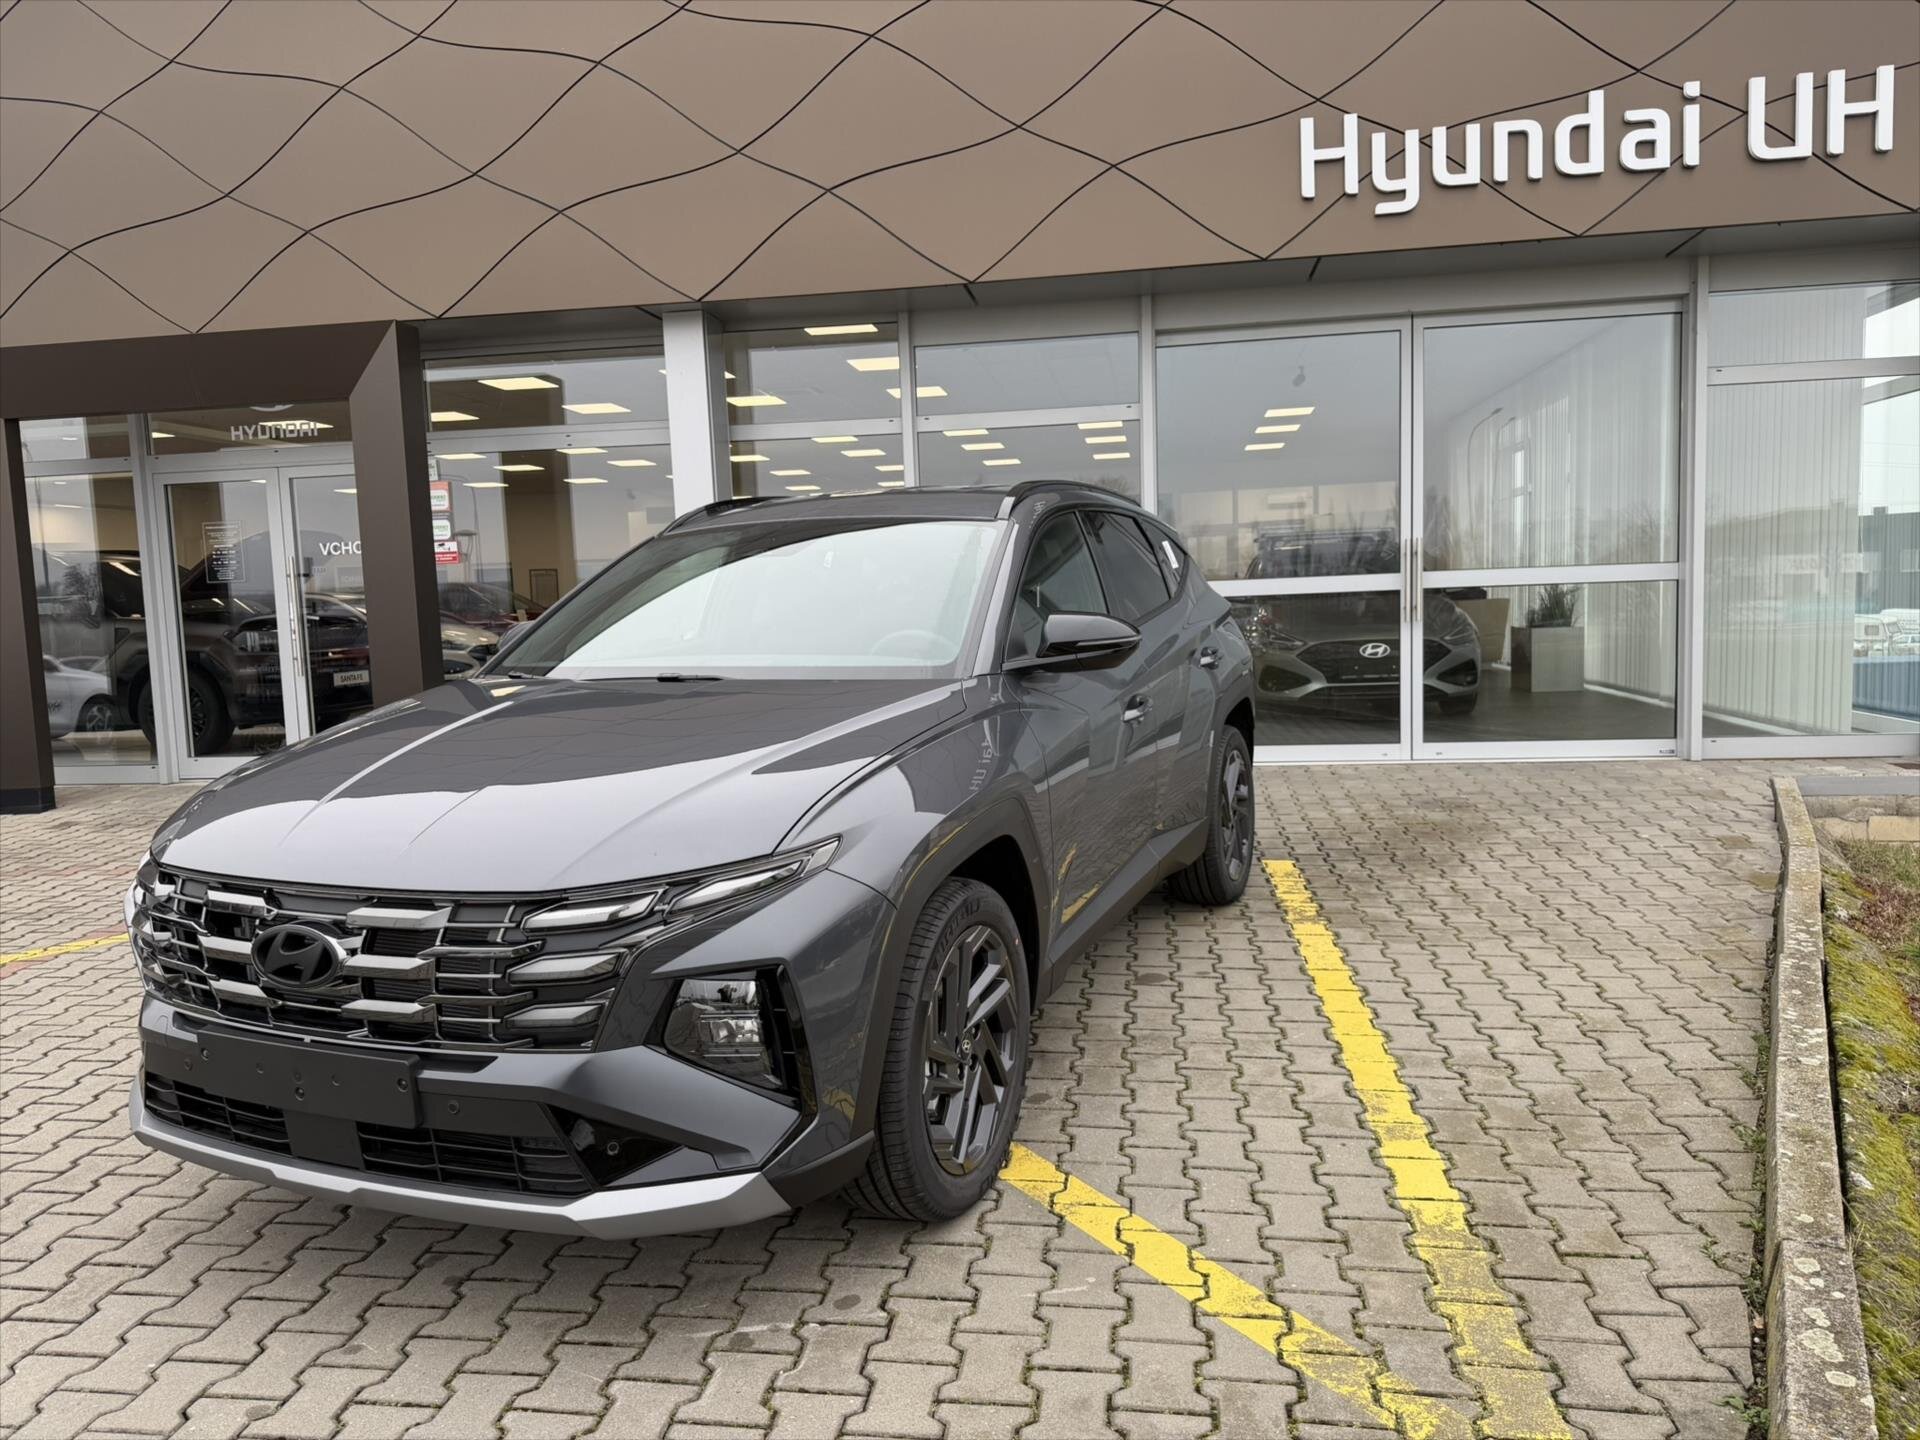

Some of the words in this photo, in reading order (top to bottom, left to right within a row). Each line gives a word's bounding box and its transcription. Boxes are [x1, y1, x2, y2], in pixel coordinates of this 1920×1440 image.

[1300, 81, 1700, 216] Hyundai
[1747, 64, 1895, 161] UH
[230, 422, 318, 441] HYUNDAI
